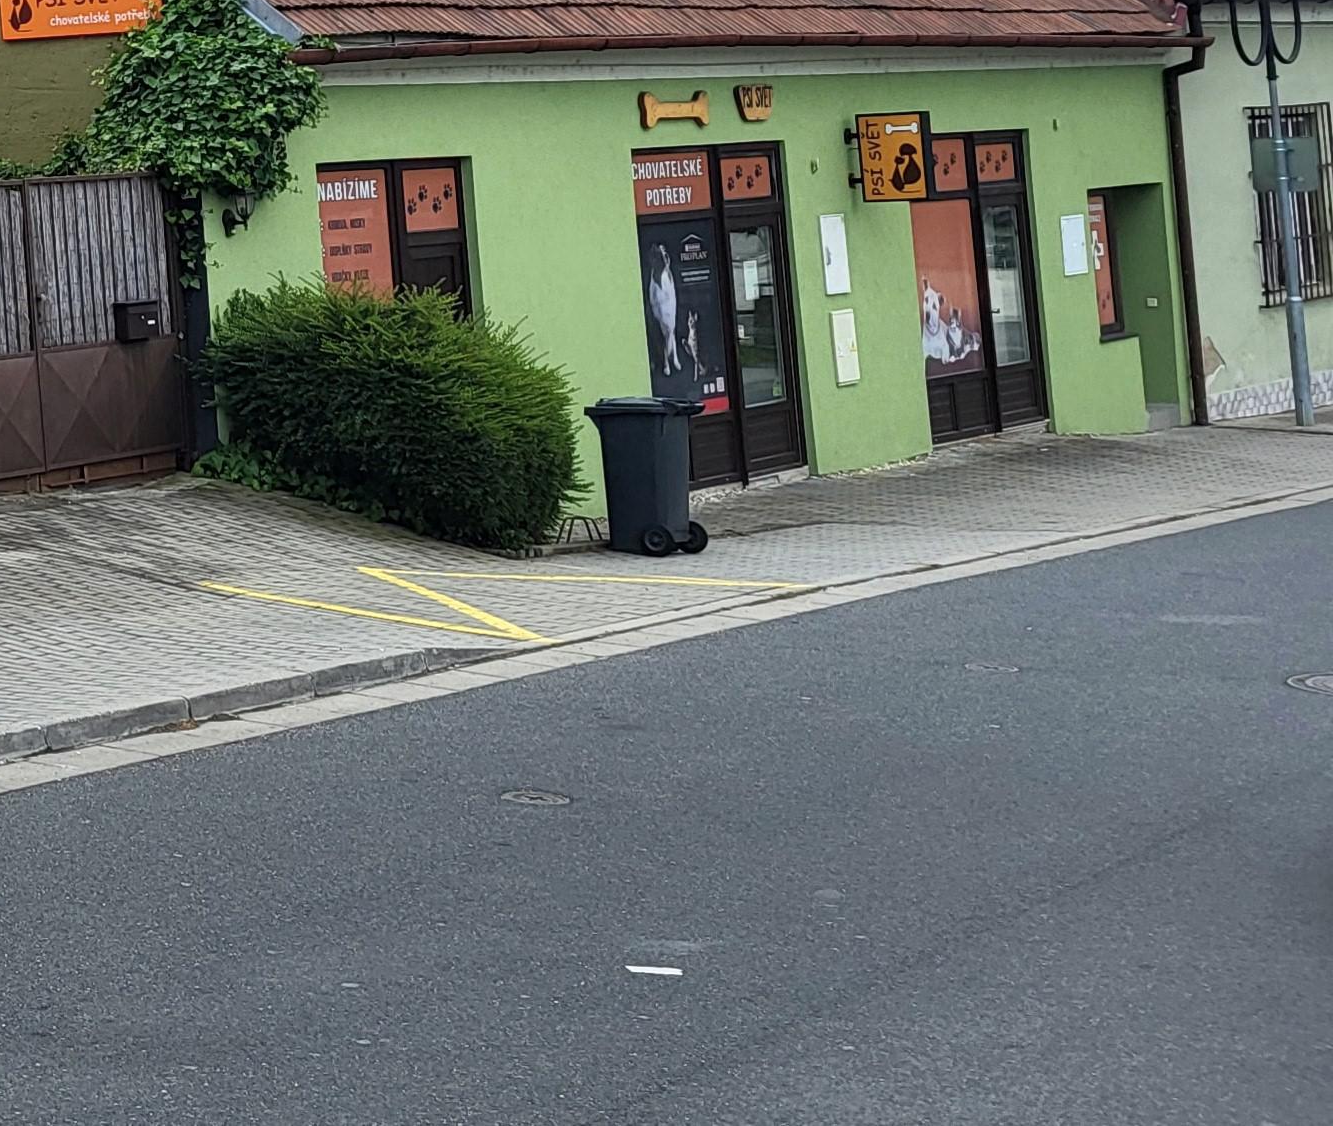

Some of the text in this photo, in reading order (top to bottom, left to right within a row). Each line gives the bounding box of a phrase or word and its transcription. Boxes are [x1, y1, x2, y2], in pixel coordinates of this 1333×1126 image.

[49, 10, 111, 27] chovatelské
[631, 156, 703, 181] CHOVATELSKÉ
[860, 120, 886, 196] PSÍ SVĚT
[317, 177, 379, 202] NABÍZÍME
[645, 184, 692, 207] POTŘEBY
